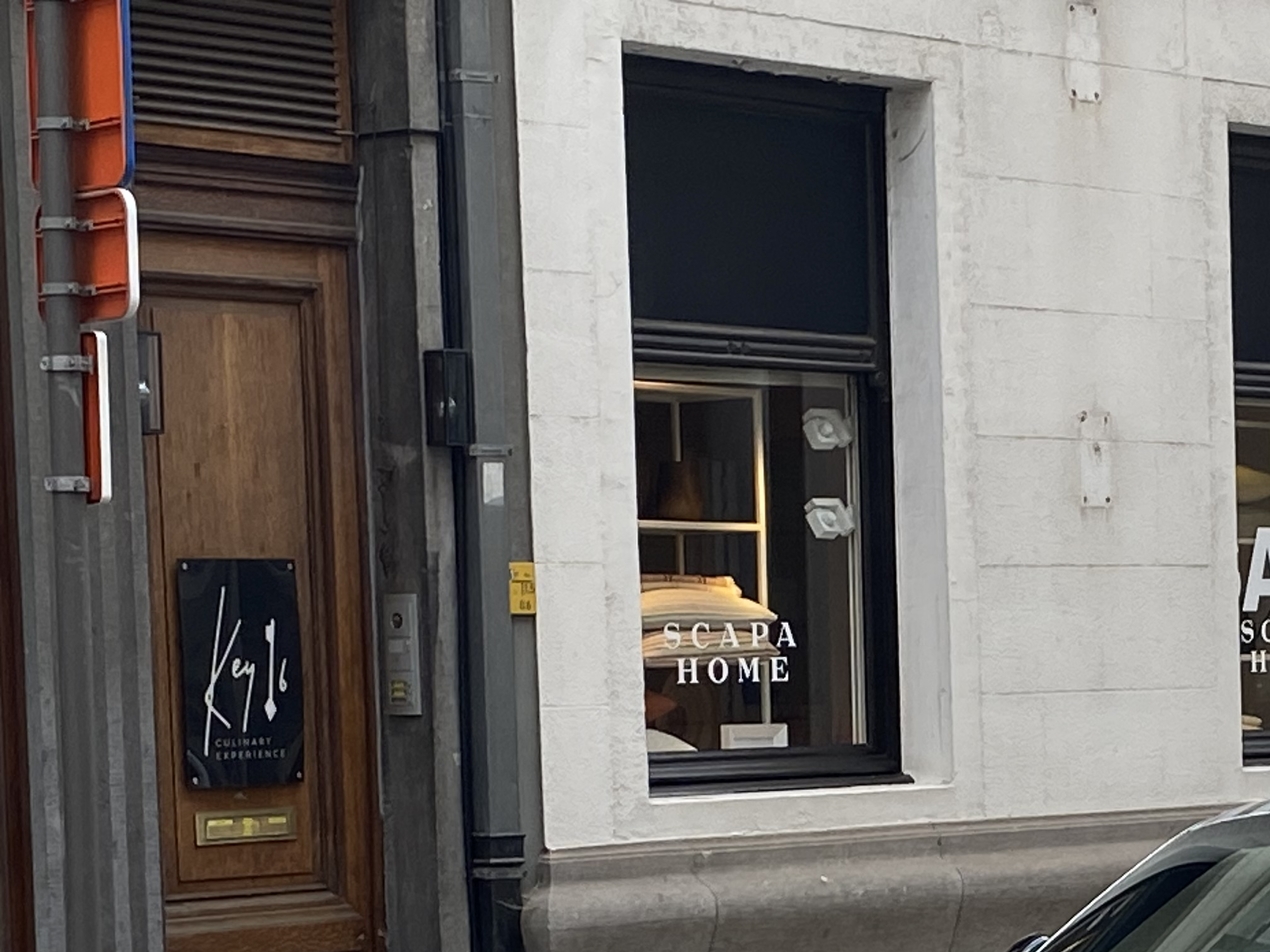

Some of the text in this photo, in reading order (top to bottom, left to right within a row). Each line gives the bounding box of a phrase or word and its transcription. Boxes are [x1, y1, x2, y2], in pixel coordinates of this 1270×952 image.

[663, 622, 797, 649] SCAPA
[676, 657, 790, 684] HOME
[215, 736, 272, 748] CULINARY
[215, 749, 286, 760] EXPERIENCE
